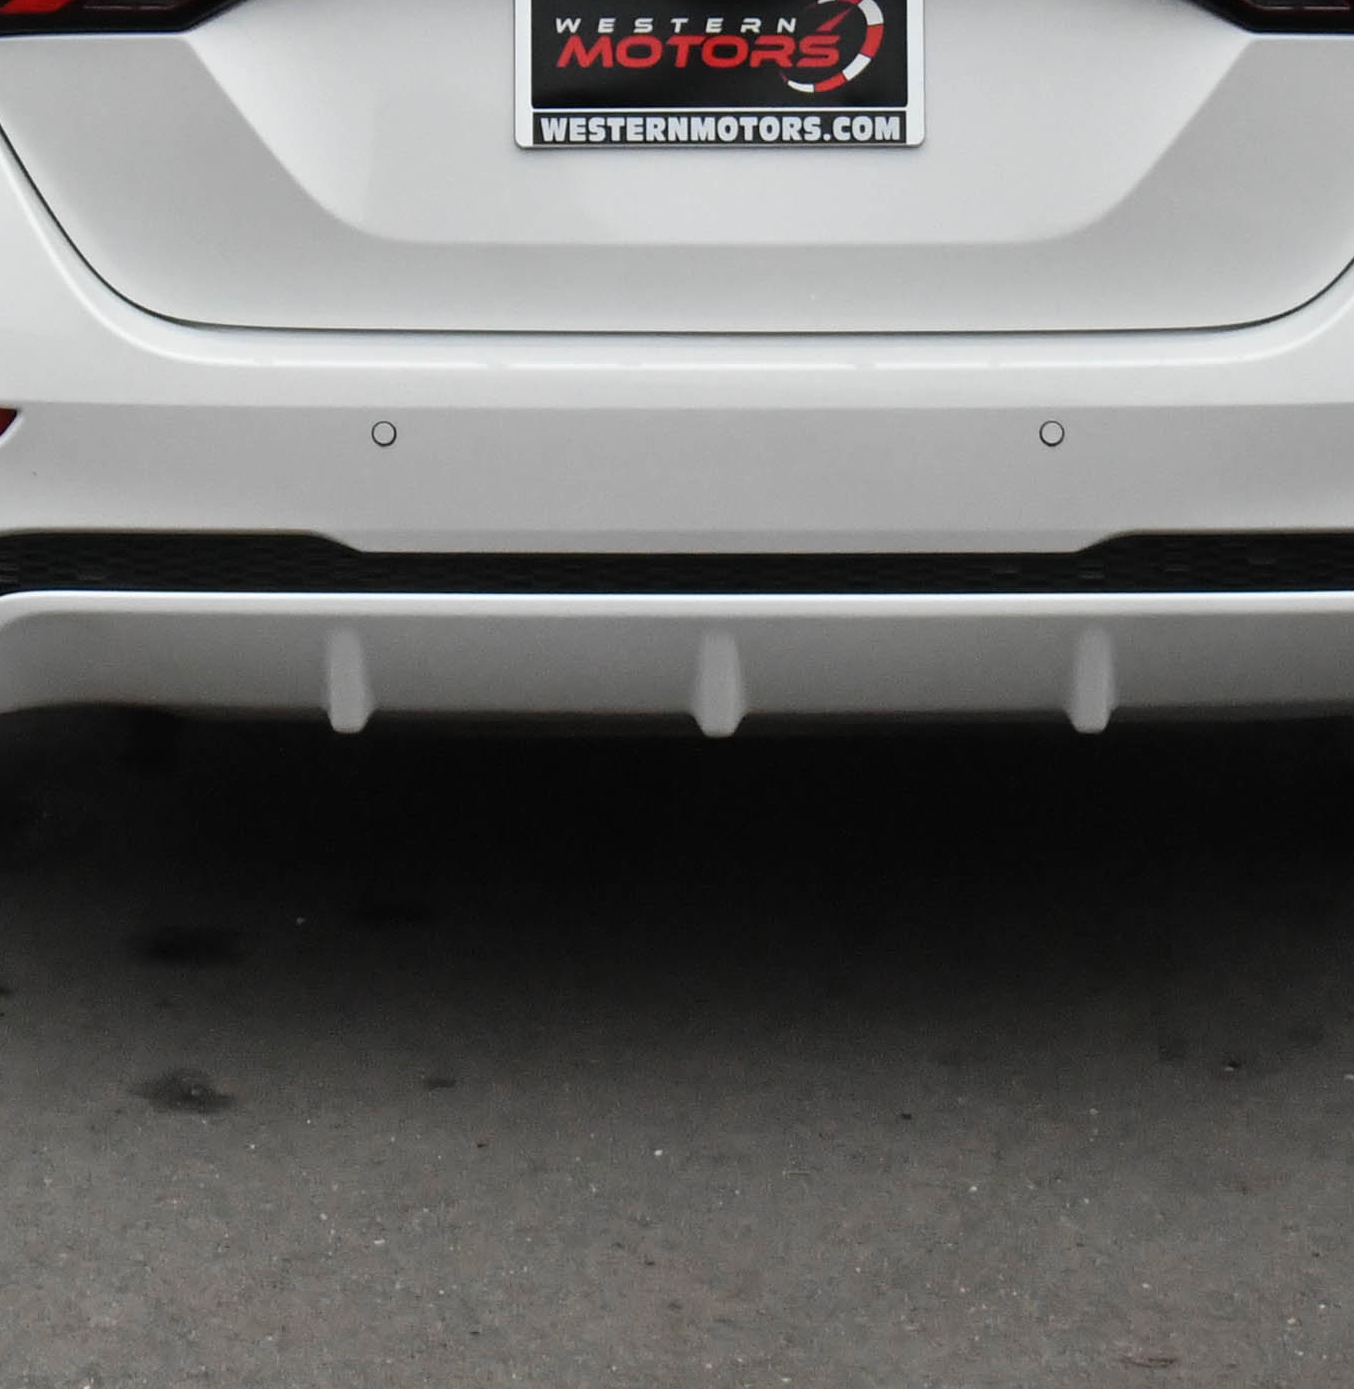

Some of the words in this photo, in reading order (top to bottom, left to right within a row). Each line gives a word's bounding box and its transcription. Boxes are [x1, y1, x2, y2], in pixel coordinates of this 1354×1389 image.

[555, 17, 798, 34] WESTERN
[556, 34, 841, 68] MOTORS
[540, 116, 901, 142] WESTERNMOTORS.COM
